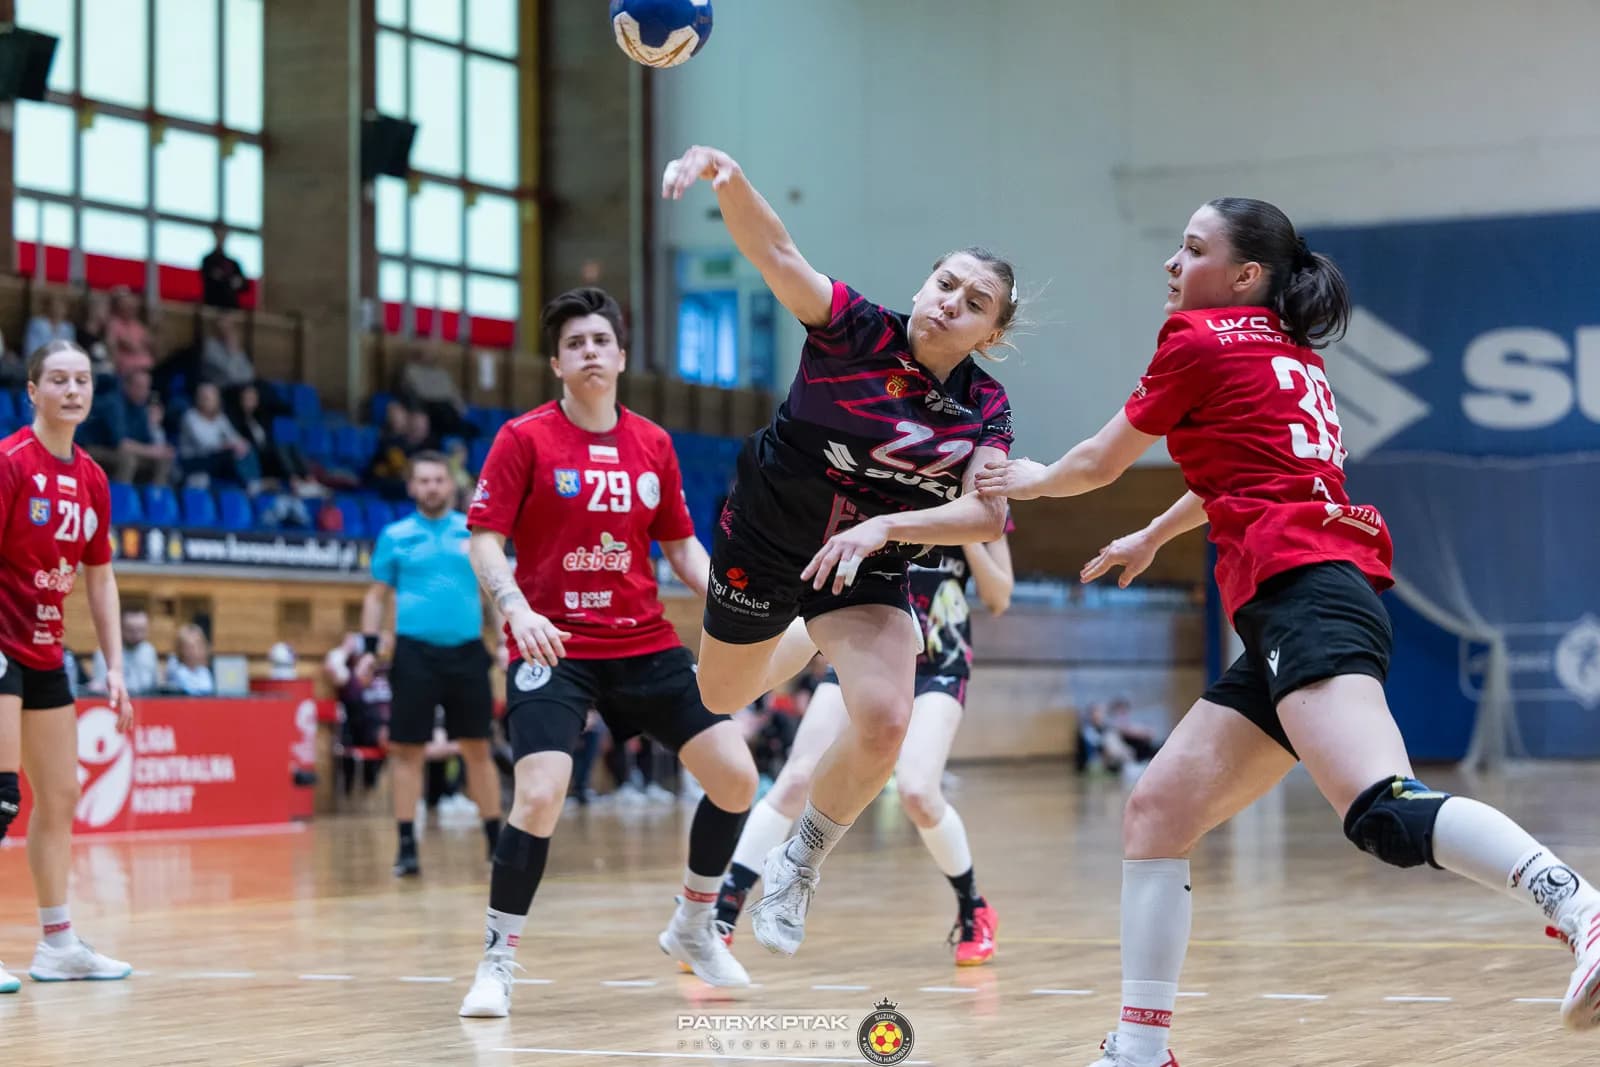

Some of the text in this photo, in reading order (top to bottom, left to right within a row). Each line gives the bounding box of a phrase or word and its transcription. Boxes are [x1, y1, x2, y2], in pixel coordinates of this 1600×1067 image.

[1461, 325, 1600, 430] S
[1271, 355, 1348, 471] 39
[871, 420, 974, 478] 22
[584, 469, 632, 513] 29
[54, 499, 81, 542] 21
